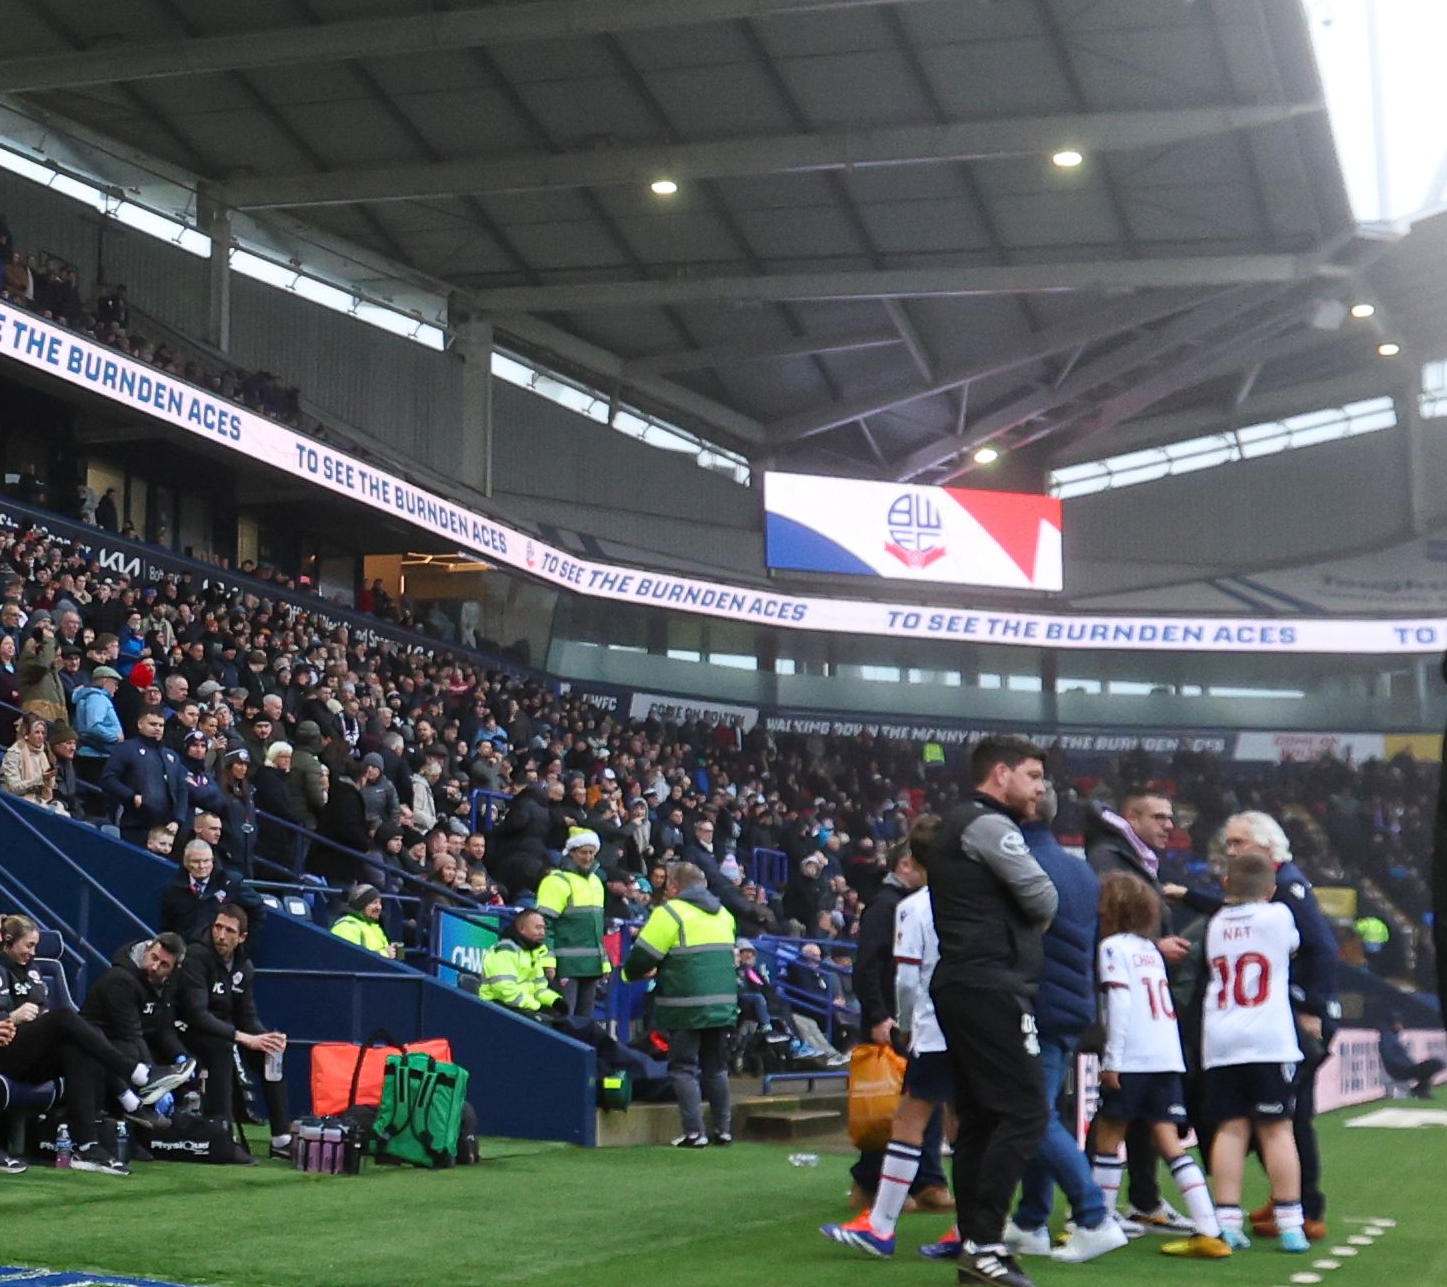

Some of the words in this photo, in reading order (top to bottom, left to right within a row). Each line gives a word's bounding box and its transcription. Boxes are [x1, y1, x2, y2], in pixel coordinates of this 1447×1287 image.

[12, 319, 61, 366] THE
[67, 344, 185, 418] BURNDEN
[188, 398, 242, 442] ACES
[295, 442, 319, 474] TO
[323, 456, 355, 489] SEE
[358, 469, 391, 505] THE
[394, 486, 470, 539] BURNDEN
[472, 522, 508, 555] ACES
[542, 552, 559, 574] TO
[559, 560, 586, 585] SEE
[588, 569, 635, 594] THE
[635, 578, 747, 612] BURNDEN
[748, 597, 809, 622] ACES
[888, 610, 923, 631] TO
[927, 613, 979, 634] SEE
[987, 618, 1040, 639] THE
[1045, 622, 1204, 644] BURNDEN
[1212, 625, 1297, 645] ACES
[1394, 627, 1437, 645] TO
[1223, 925, 1252, 941] NAT
[1211, 951, 1272, 1011] 10
